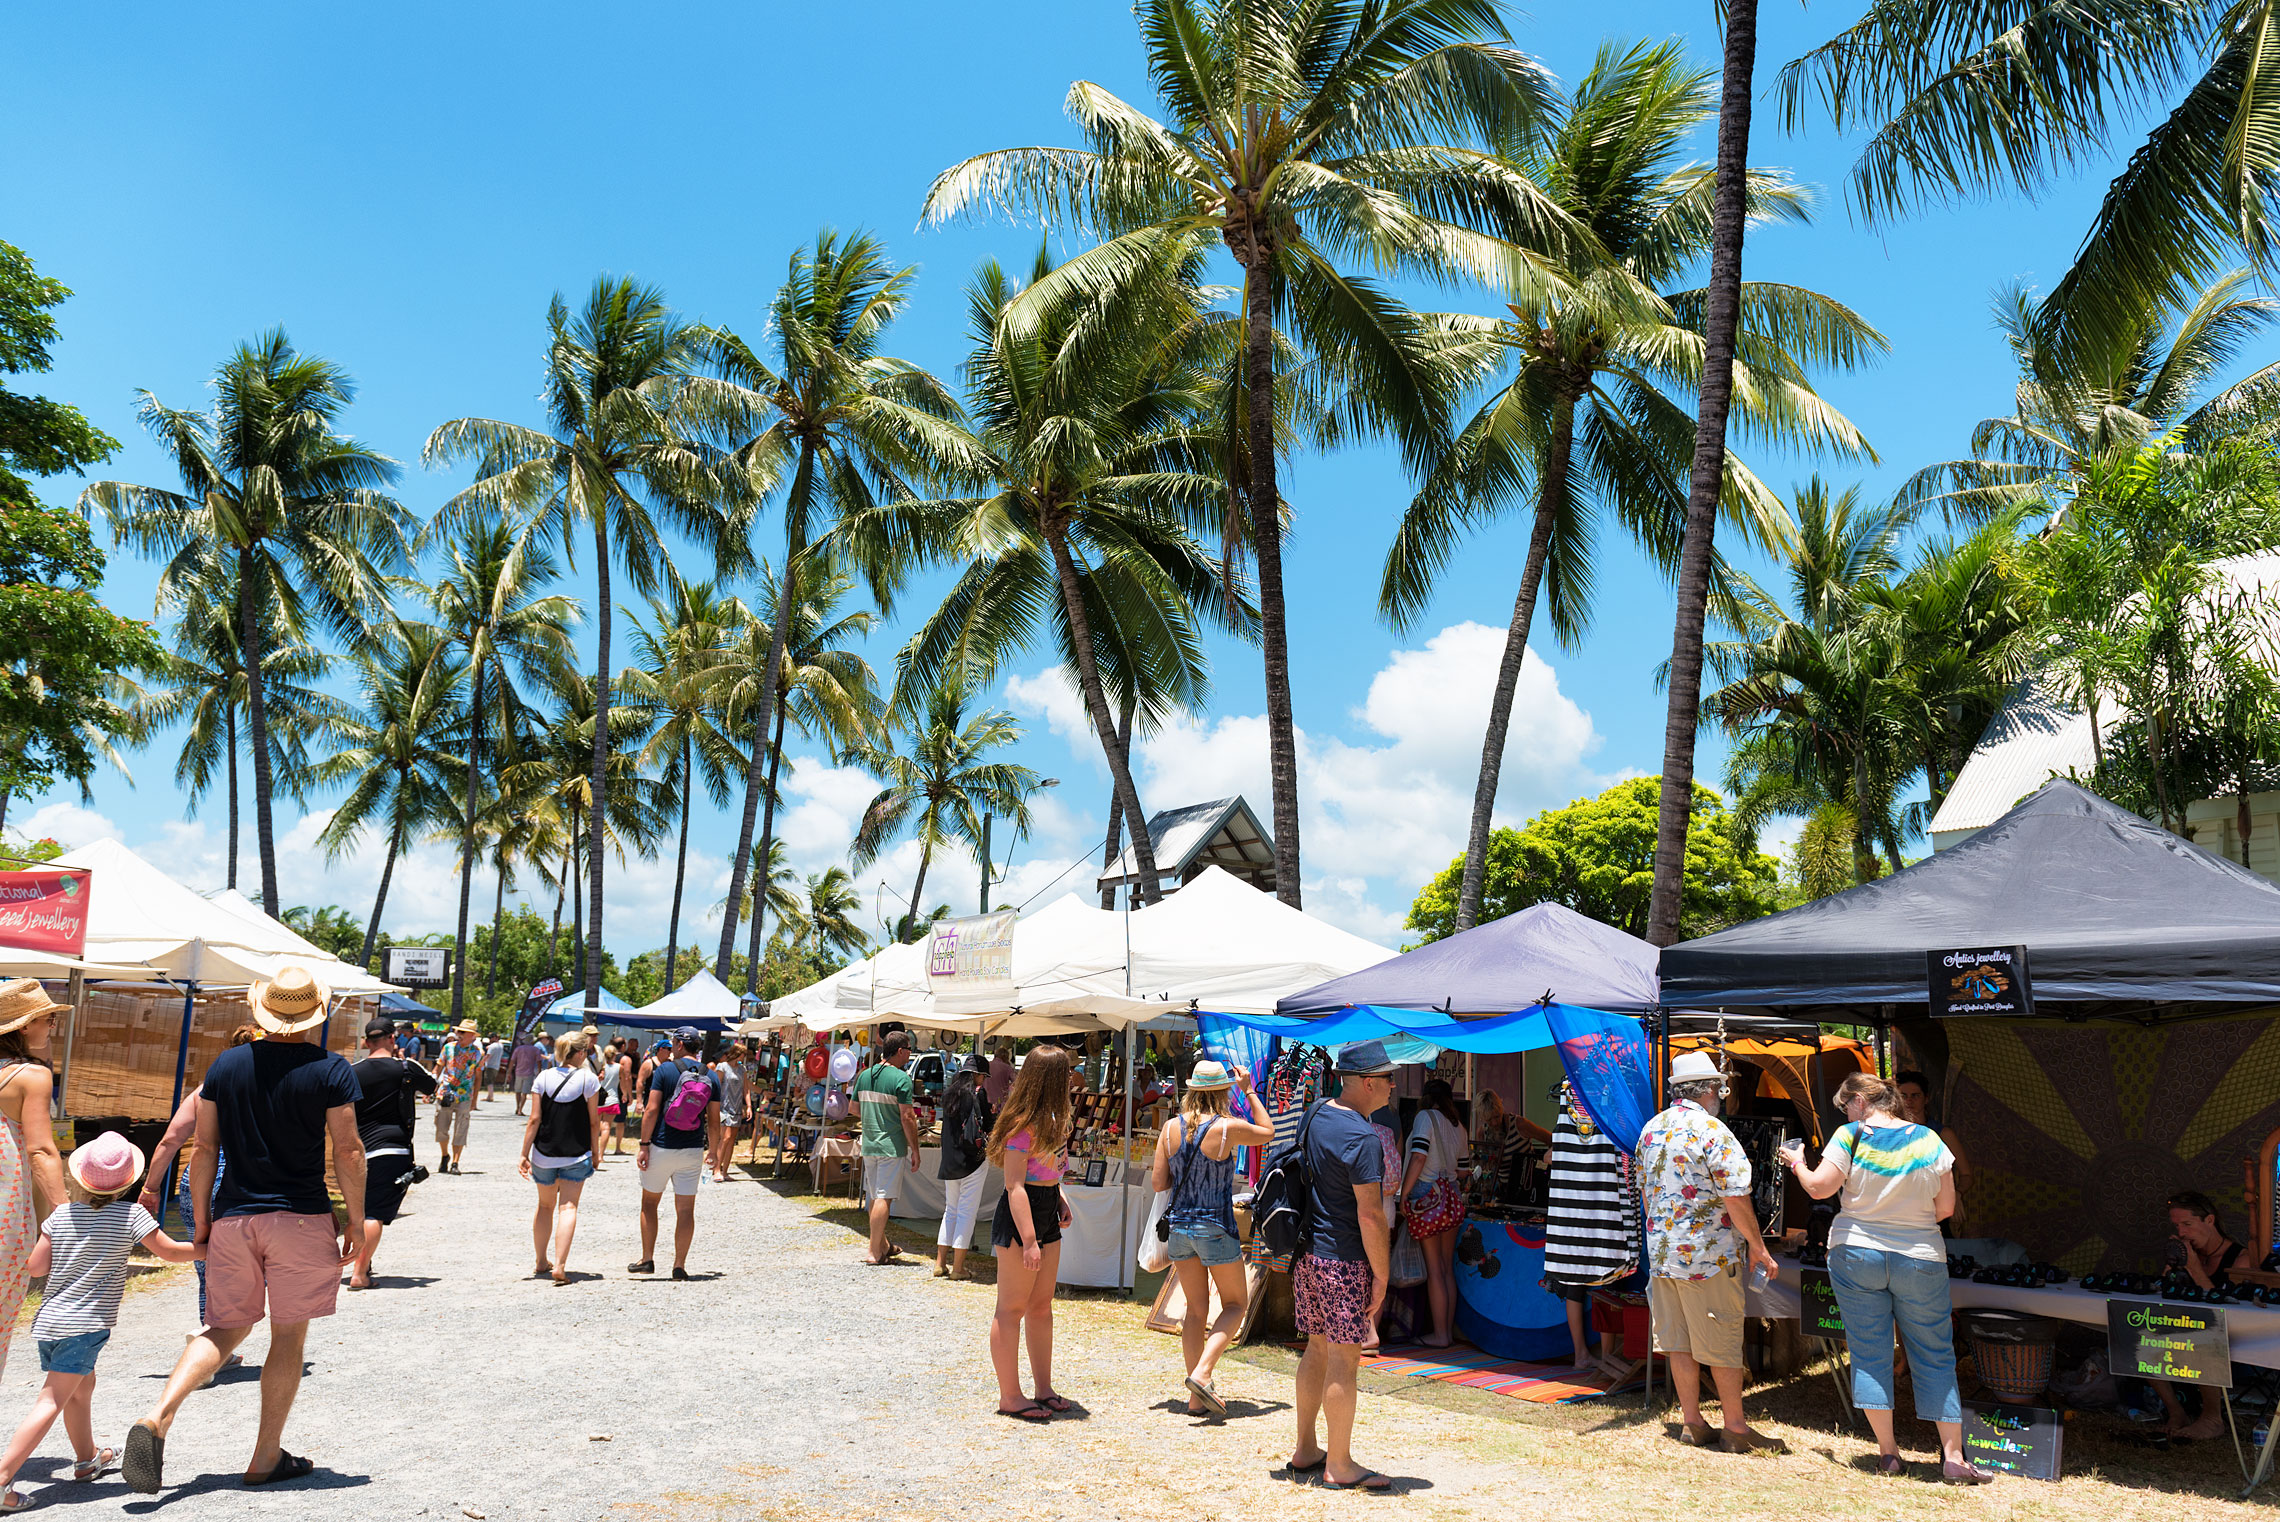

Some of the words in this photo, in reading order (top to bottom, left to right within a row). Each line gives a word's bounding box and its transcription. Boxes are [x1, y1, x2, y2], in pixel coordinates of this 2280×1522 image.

[1943, 951, 1975, 969] Antics
[1975, 950, 2011, 966] jewellery
[532, 983, 561, 996] OPAL
[2127, 1307, 2206, 1332] Australian
[2140, 1335, 2195, 1352] Ironbark
[2163, 1351, 2174, 1362] &
[2138, 1361, 2162, 1375] Red
[2165, 1364, 2202, 1379] Cedar
[1974, 1457, 1991, 1467] Port
